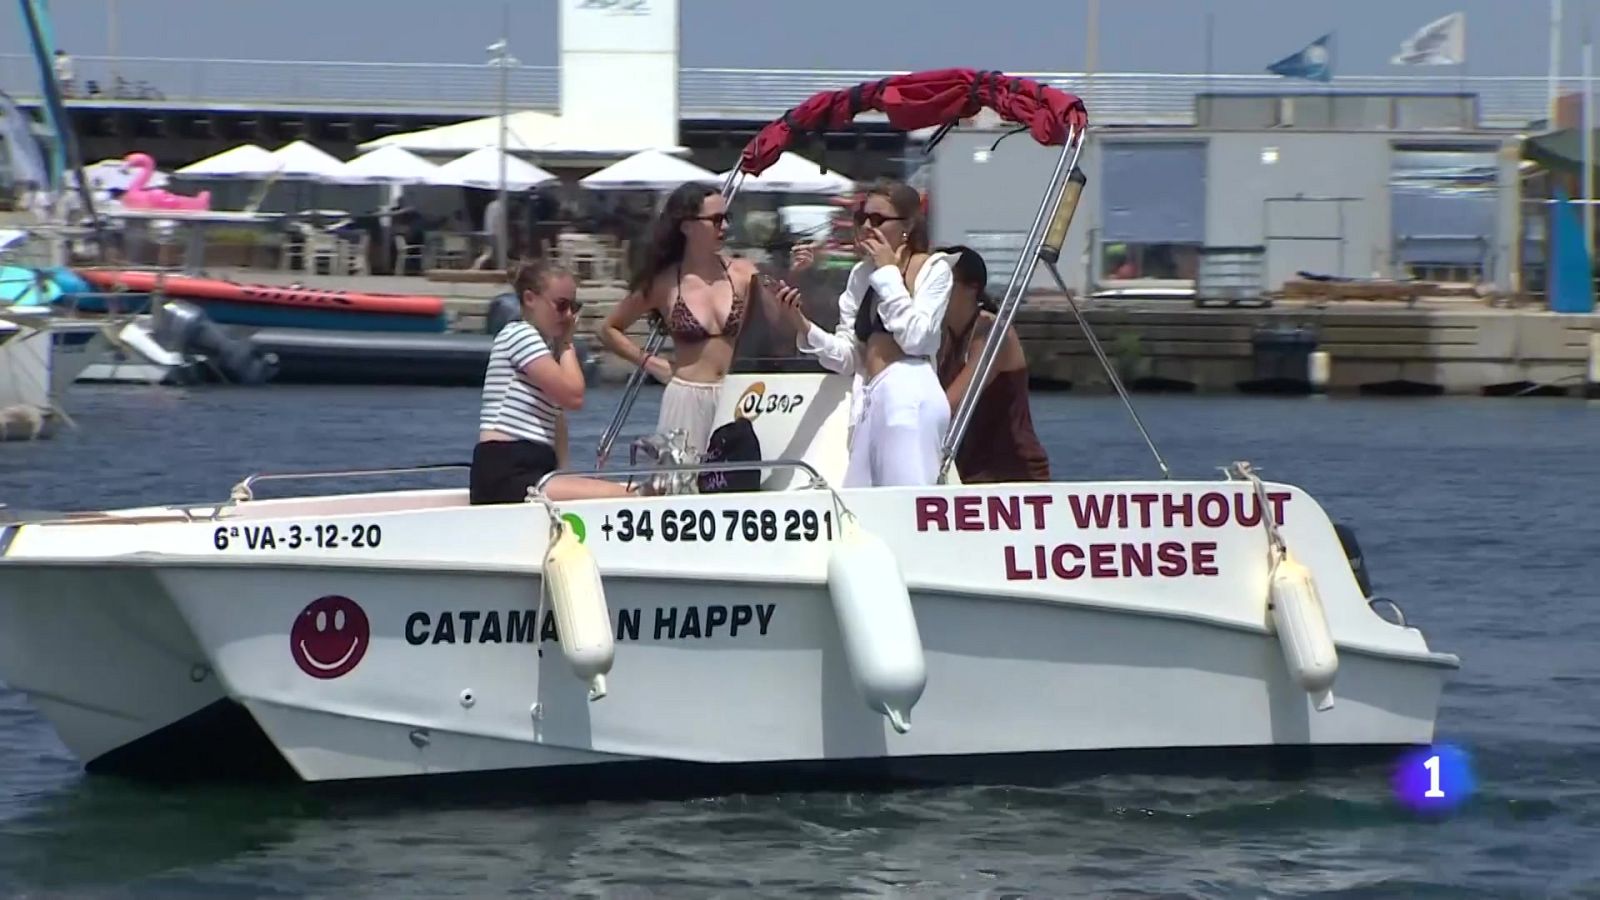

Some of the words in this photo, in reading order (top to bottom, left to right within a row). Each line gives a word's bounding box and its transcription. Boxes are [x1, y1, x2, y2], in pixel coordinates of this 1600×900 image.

[601, 508, 654, 542] +34
[660, 508, 716, 542] 620
[722, 508, 778, 542] 768
[784, 508, 833, 542] 291
[915, 494, 1053, 531] RENT
[1068, 491, 1292, 530] WITHOUT
[244, 524, 382, 550] VA-3-12-20
[1004, 541, 1219, 580] LICENSE
[405, 608, 641, 645] CATAMAN
[653, 603, 776, 641] HAPPY
